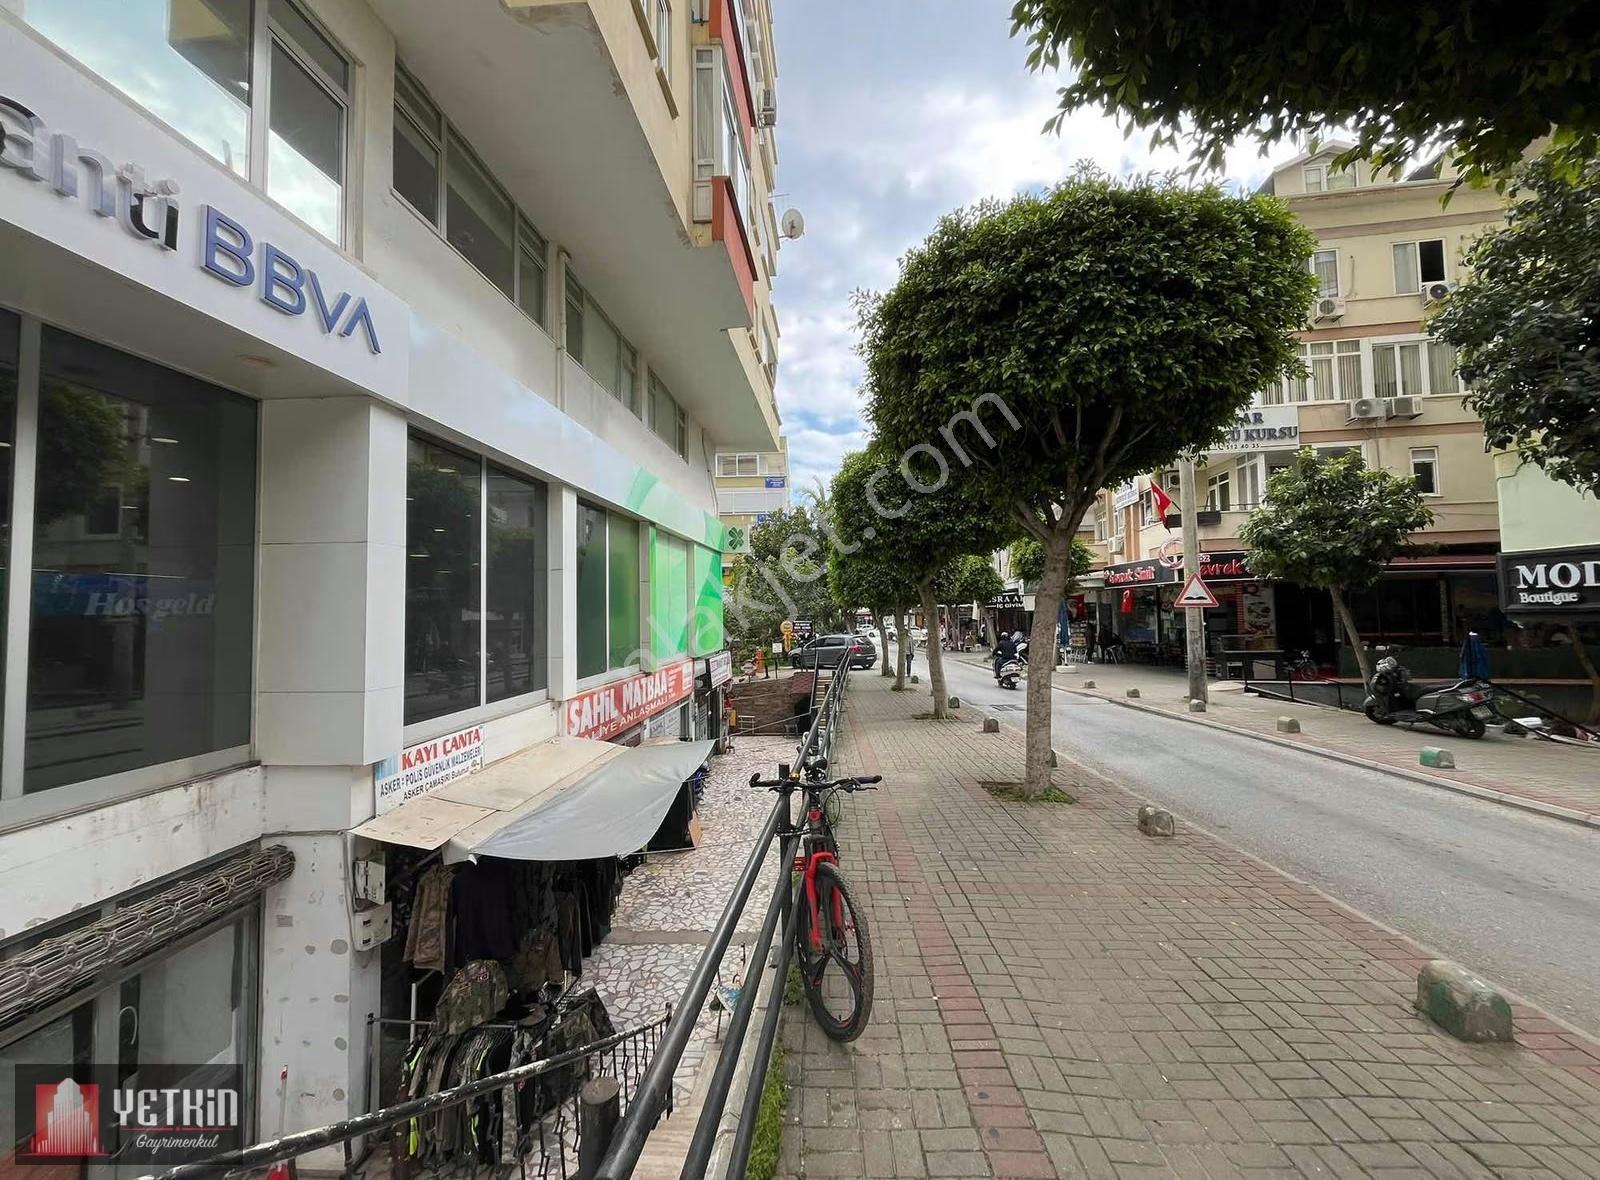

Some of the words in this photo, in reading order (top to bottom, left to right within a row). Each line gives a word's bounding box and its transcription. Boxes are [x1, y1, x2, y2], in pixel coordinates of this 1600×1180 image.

[200, 204, 382, 355] BBVA
[1244, 426, 1299, 442] KURSU
[1199, 559, 1243, 576] evrek
[989, 595, 1010, 603] SRA
[622, 670, 668, 714] MATBAA
[401, 743, 438, 771] KAYI
[443, 728, 481, 757] ÇANTA
[380, 779, 402, 797] ASKER
[402, 785, 425, 801] ASKER
